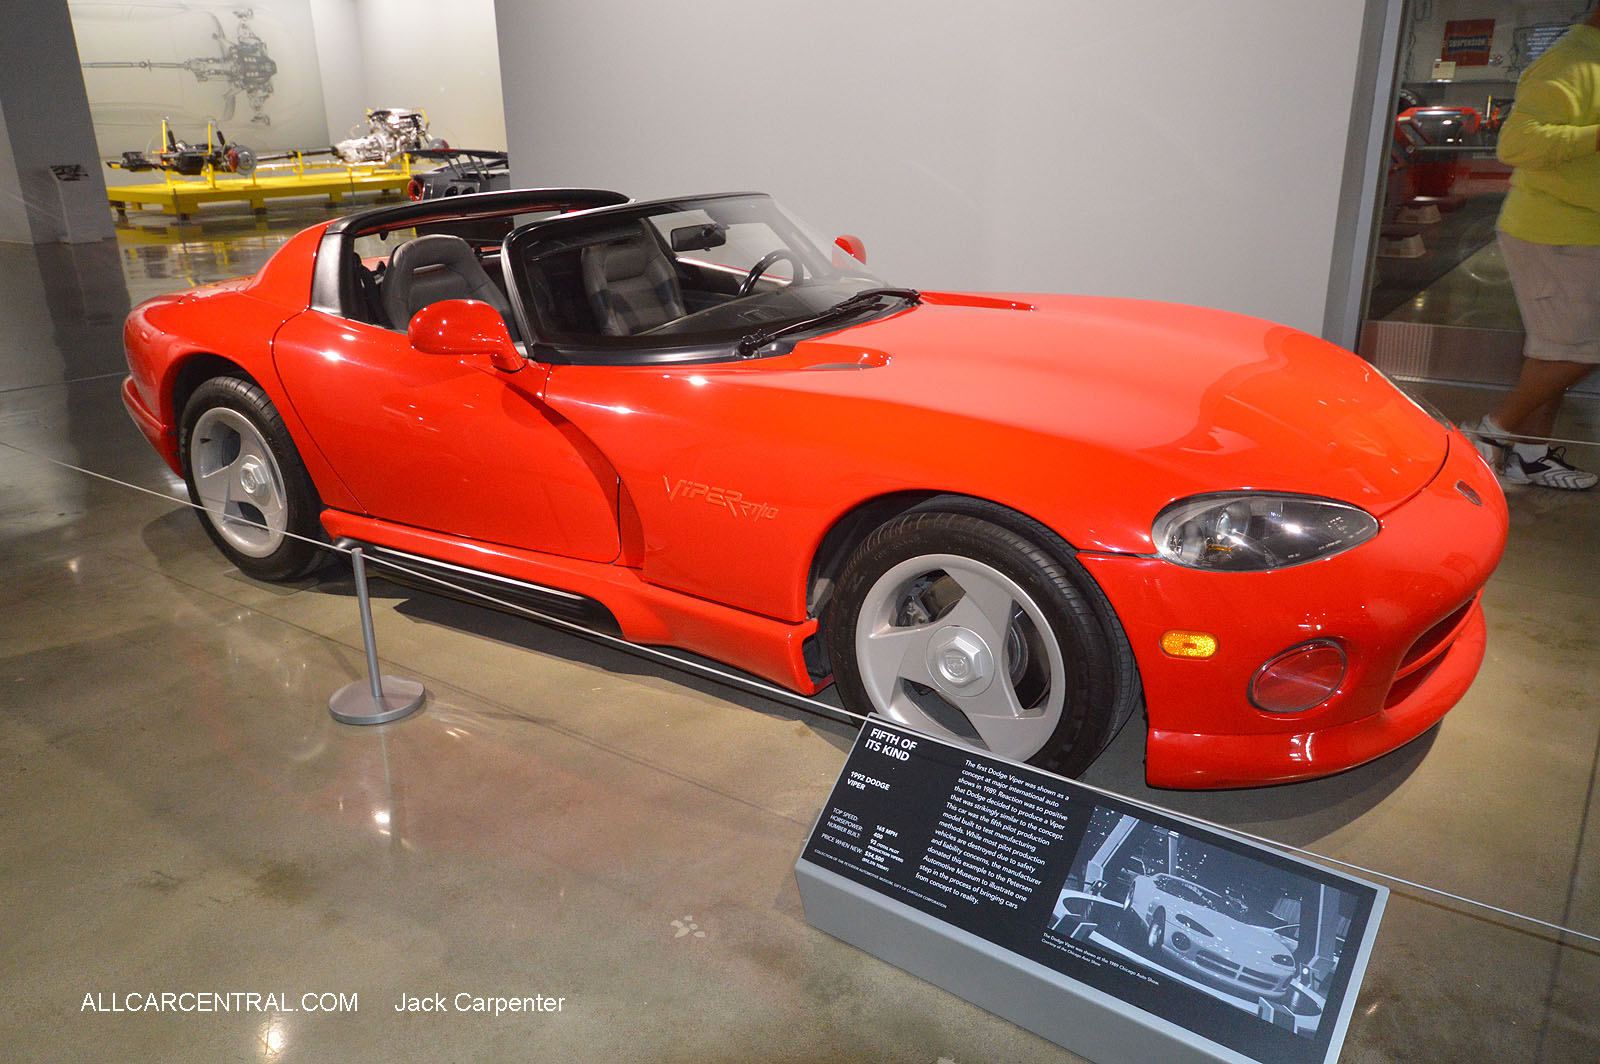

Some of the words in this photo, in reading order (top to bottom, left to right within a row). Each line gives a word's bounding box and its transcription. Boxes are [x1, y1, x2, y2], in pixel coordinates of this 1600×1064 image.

[865, 739, 881, 751] ITS
[882, 745, 909, 760] KIND
[871, 728, 900, 745] FIFTH
[901, 739, 917, 750] OF
[848, 779, 865, 790] VIPER
[851, 771, 865, 781] 1992
[866, 777, 890, 790] DODGE
[962, 770, 984, 780] concept
[992, 781, 1008, 789] major
[1009, 785, 1045, 802] international
[1045, 799, 1059, 807] auto
[966, 760, 975, 768] The
[977, 764, 987, 772] first
[988, 768, 1007, 779] Dodge
[1009, 775, 1024, 784] Viper
[1037, 786, 1056, 796] shown
[954, 786, 966, 794] that
[966, 790, 986, 801] Dodge
[987, 798, 1010, 810] decided
[1018, 810, 1043, 822] produce
[1050, 820, 1065, 830] Viper
[958, 778, 975, 787] shows
[984, 786, 997, 795] 1989.
[998, 791, 1023, 804] Reaction
[1044, 810, 1067, 820] positive
[821, 833, 835, 842] PRICE
[835, 839, 850, 848] WHEN
[827, 822, 847, 832] NUMBER
[885, 829, 898, 837] MPH
[943, 813, 961, 822] model
[961, 818, 974, 827] built
[983, 827, 994, 835] test
[994, 832, 1036, 852] manufacturing
[947, 802, 957, 811] This
[980, 815, 989, 823] the
[991, 819, 1002, 827] fifth
[1002, 825, 1016, 833] pilot
[1017, 831, 1049, 845] production
[974, 804, 999, 817] strikingly
[1000, 813, 1019, 823] similar
[1038, 828, 1063, 840] concept.
[935, 830, 956, 841] vehicles
[968, 842, 997, 856] destroyed
[997, 853, 1008, 861] due
[1017, 862, 1035, 873] safety
[939, 821, 964, 834] methods.
[966, 830, 982, 840] While
[983, 838, 997, 847] most
[998, 844, 1012, 852] pilot
[1012, 850, 1045, 865] production
[923, 855, 955, 872] Automotive
[956, 868, 980, 882] Museum
[989, 882, 1014, 896] illustrate
[928, 847, 951, 859] donated
[952, 856, 961, 864] this
[963, 862, 987, 874] example
[996, 874, 1006, 882] the
[1007, 878, 1032, 892] Petersen
[943, 842, 963, 855] liability
[963, 852, 989, 865] concerns,
[1002, 867, 1041, 885] manufacturer
[916, 872, 928, 882] from
[930, 880, 952, 892] concept
[960, 893, 978, 904] reality.
[920, 865, 932, 873] step
[939, 872, 949, 880] the
[949, 878, 971, 889] process
[980, 889, 1004, 904] bringing
[1005, 901, 1017, 909] cars
[1051, 936, 1064, 944] Dodge
[1119, 965, 1136, 975] Chicago
[1067, 950, 1081, 958] Chicago
